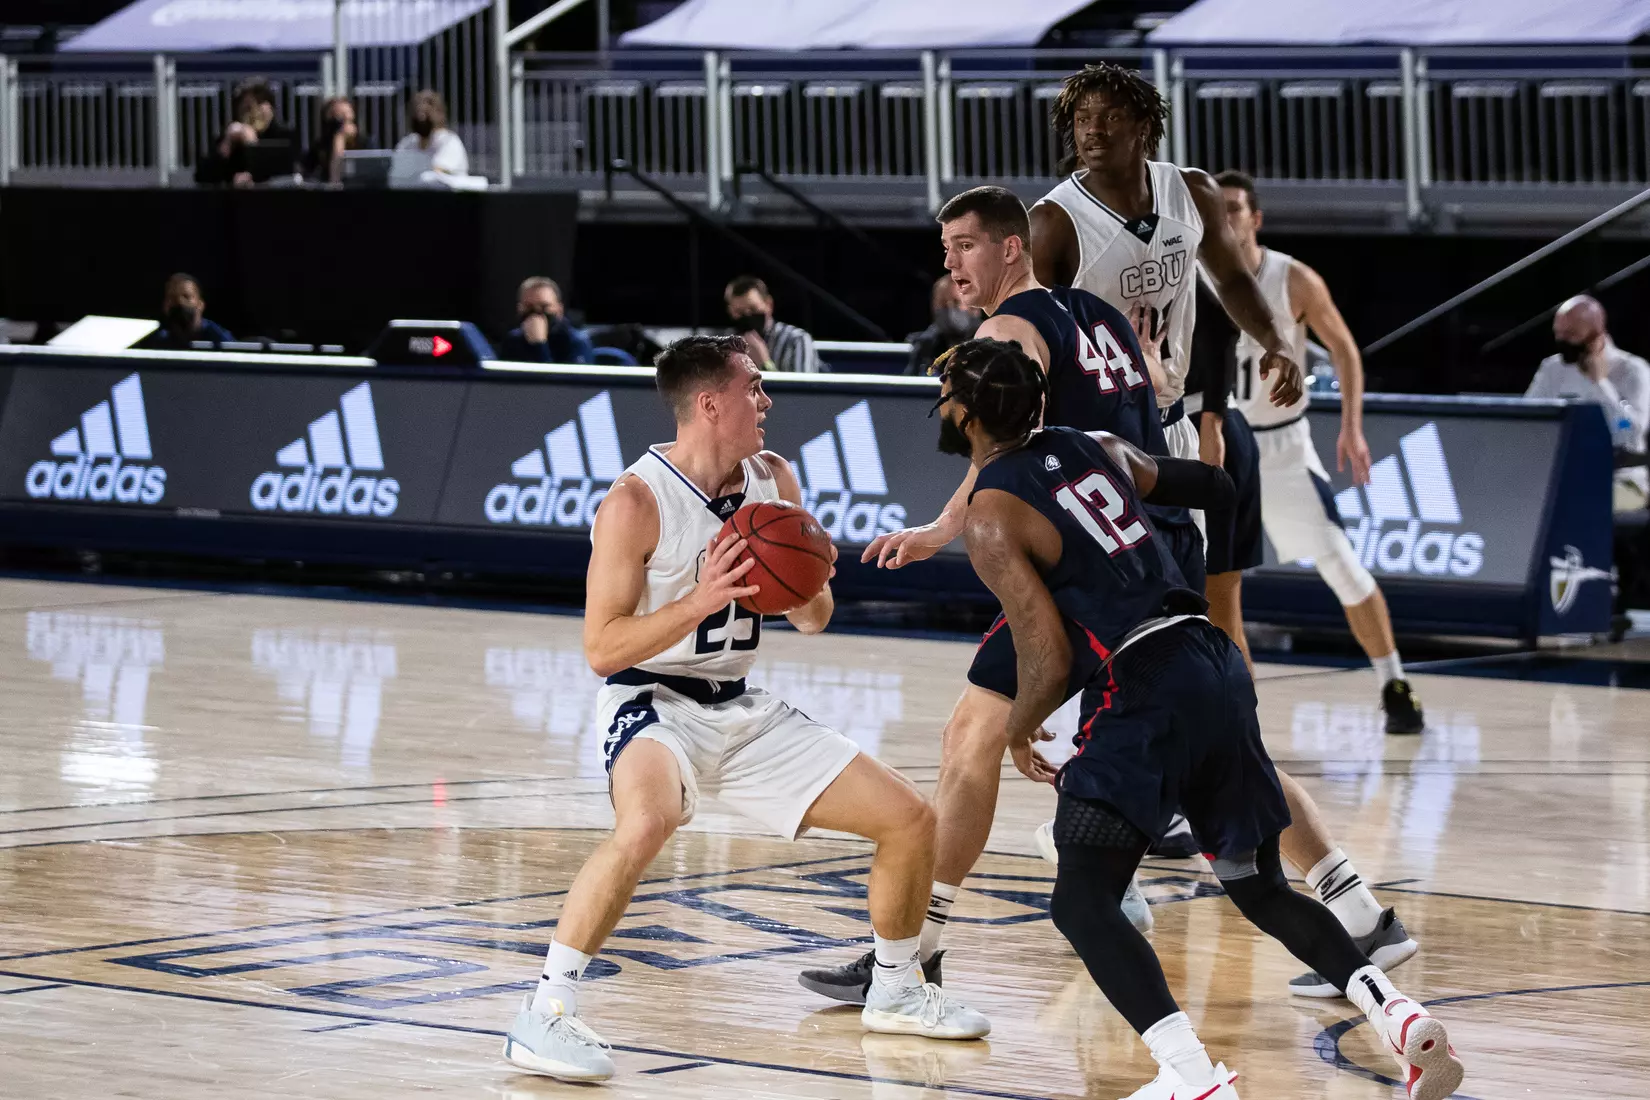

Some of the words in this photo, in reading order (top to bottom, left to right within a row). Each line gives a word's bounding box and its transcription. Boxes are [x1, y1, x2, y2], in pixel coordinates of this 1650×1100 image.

[1162, 235, 1183, 247] WAC
[1120, 250, 1187, 300] CBU
[1077, 320, 1148, 394] 44
[24, 454, 167, 505] adidas
[249, 463, 400, 517] adidas
[484, 475, 609, 527] adid
[799, 488, 908, 542] idas
[1051, 468, 1152, 558] 12
[1296, 515, 1486, 577] didas
